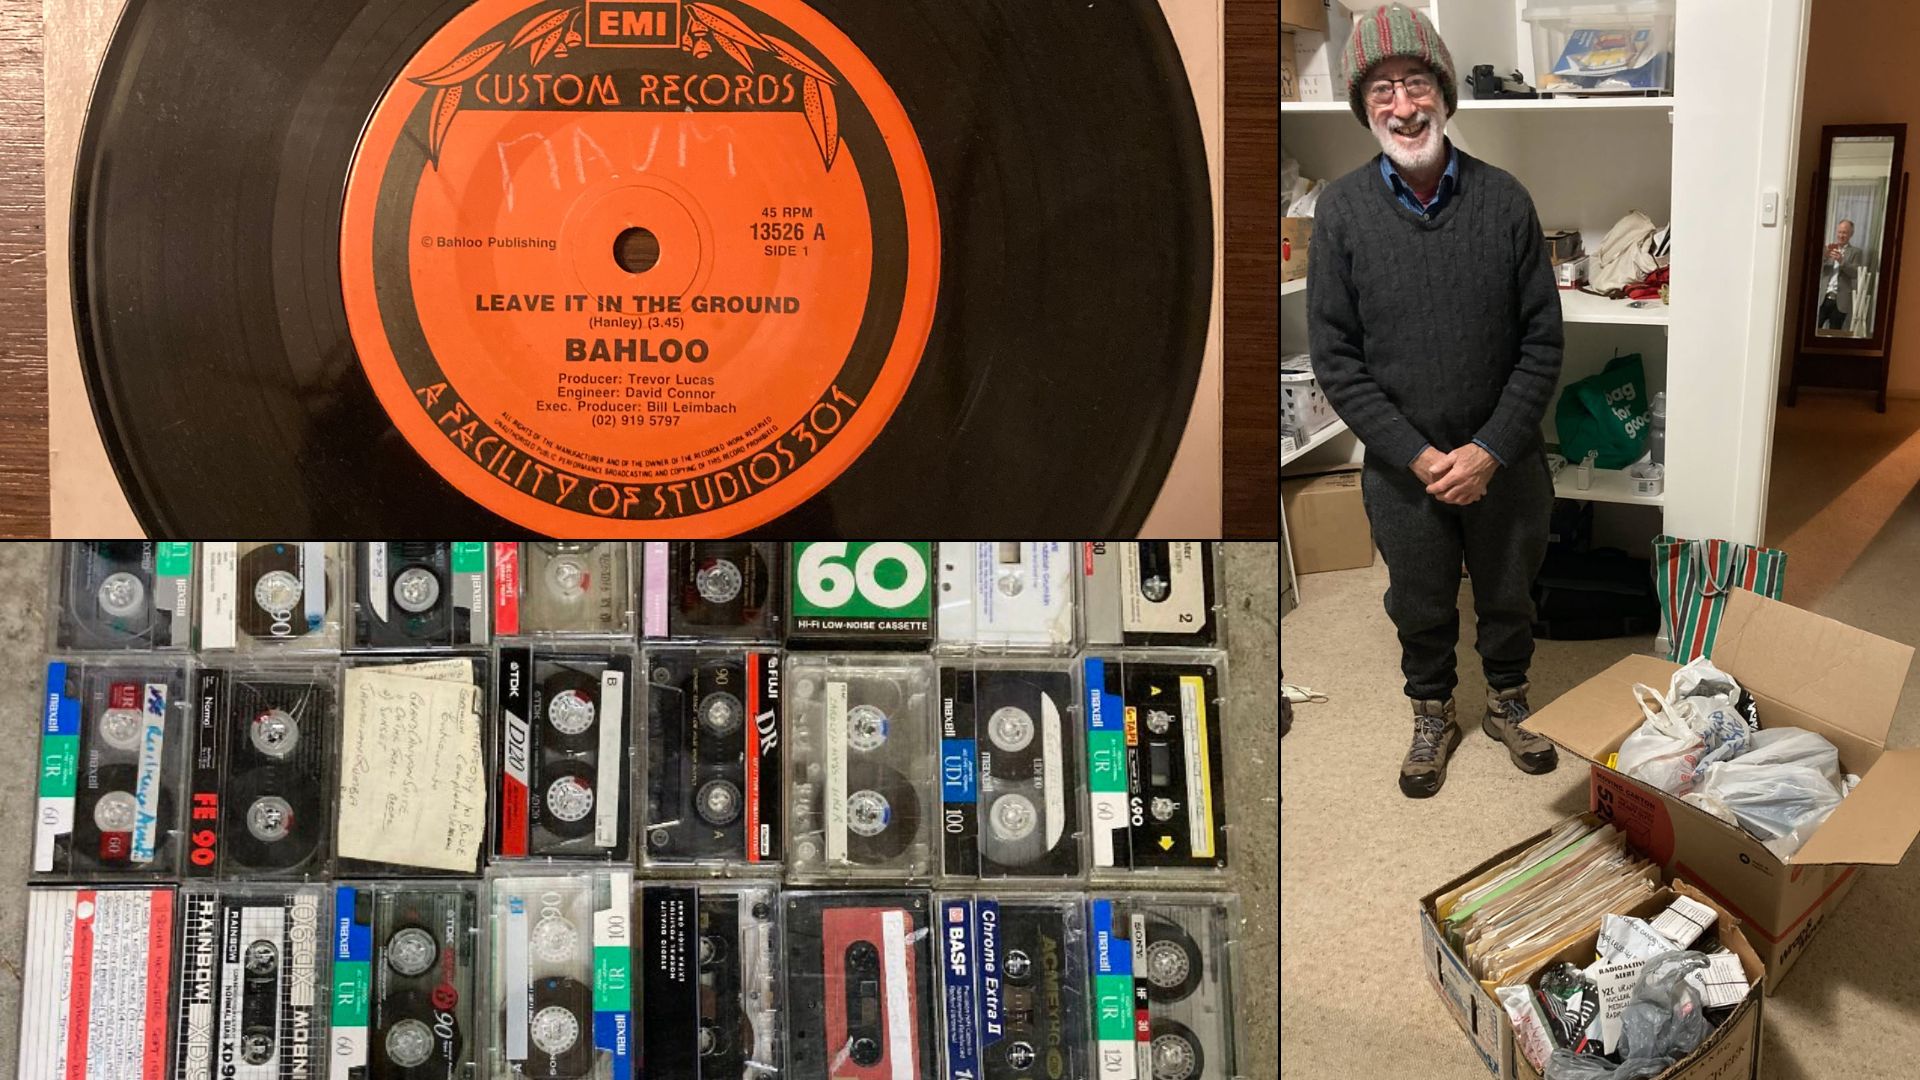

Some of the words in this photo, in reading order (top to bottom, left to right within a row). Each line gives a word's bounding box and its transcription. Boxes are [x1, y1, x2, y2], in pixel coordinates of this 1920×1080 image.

[601, 11, 667, 36] EMI
[475, 73, 619, 106] CUSTOM
[640, 73, 796, 106] RECORDS
[761, 207, 778, 219] 45
[782, 207, 814, 219] RPM
[436, 236, 484, 249] Bahloo
[487, 236, 557, 252] Publishing
[749, 223, 805, 242] 13526
[813, 224, 827, 242] A
[764, 245, 798, 257] SIDE
[802, 245, 809, 257] 1
[475, 295, 555, 313] LEAVE
[564, 295, 590, 313] IT
[597, 295, 624, 313] IN
[633, 295, 683, 314] THE
[691, 296, 800, 315] GROUND
[588, 316, 644, 331] (Hanley)
[647, 316, 685, 331] (3.45)
[564, 338, 710, 364] BAHLOO
[558, 373, 623, 386] Producer:
[628, 373, 671, 386] Trevor
[675, 374, 715, 387] Lucas
[557, 386, 620, 401] Engineer:
[625, 387, 662, 400] David
[665, 387, 716, 400] Connor
[536, 400, 573, 413] Exec.
[577, 400, 642, 413] Producer:
[647, 400, 669, 414] Bill
[673, 401, 737, 415] Leimbach
[1611, 404, 1632, 421] for
[591, 414, 617, 428] (02)
[621, 414, 646, 427] 919
[649, 414, 681, 427] 5797
[416, 382, 447, 408] A
[437, 402, 579, 507] FACILITY
[589, 484, 642, 518] OF
[653, 438, 797, 518] STUDIOS
[790, 384, 857, 455] 301
[797, 542, 928, 609] 60
[176, 578, 188, 617] maxell
[471, 574, 482, 613] maxell
[270, 609, 291, 635] 90
[798, 620, 820, 630] HI-FI
[822, 620, 876, 631] LOW-NOISE
[878, 621, 928, 632] CASSETTE
[1179, 613, 1193, 624] 2
[509, 669, 520, 698] TDK
[606, 676, 618, 687] B
[715, 668, 729, 685] 90
[767, 669, 779, 699] FUJI
[122, 685, 136, 708] UR
[1150, 686, 1163, 696] A
[48, 692, 60, 733] maxell
[203, 696, 215, 728] Normal
[532, 697, 541, 720] TDK
[944, 698, 956, 737] maxell
[1091, 689, 1104, 728] maxell
[753, 708, 779, 757] DR
[45, 755, 59, 778] UR
[87, 750, 99, 790] maxell
[945, 755, 962, 787] UDI
[981, 752, 992, 792] maxell
[1095, 750, 1111, 773] UR
[41, 807, 59, 826] 60
[193, 793, 218, 820] FE
[1096, 801, 1115, 821] 60
[946, 808, 964, 834] 100
[108, 837, 122, 854] 60
[191, 829, 217, 866] 90
[714, 830, 724, 840] A
[541, 891, 563, 920] 90
[660, 900, 668, 936] QUALITY
[677, 900, 685, 928] GRADE
[290, 904, 317, 946] 90
[445, 919, 456, 944] TDK
[608, 915, 625, 941] 100
[669, 900, 677, 941] POSITION
[227, 911, 239, 963] RAINBOW
[339, 918, 351, 959] maxell
[981, 910, 997, 974] Chrome
[1133, 921, 1144, 960] SONY
[192, 901, 214, 1006] RAINBOW
[949, 927, 967, 977] BASF
[1099, 930, 1111, 972] maxell
[609, 966, 626, 991] UR
[678, 956, 686, 982] EXTRA
[1614, 970, 1635, 980] ALERT
[224, 985, 234, 1020] NORMAL
[338, 981, 355, 1007] UR
[984, 977, 1000, 1019] Extra
[1136, 987, 1147, 1000] HF
[1102, 996, 1118, 1020] UR
[433, 1009, 454, 1039] 90
[614, 1014, 627, 1057] maxell
[1137, 1018, 1149, 1032] 30
[222, 1042, 235, 1063] XD
[335, 1036, 354, 1057] 60
[514, 1063, 523, 1073] A
[1103, 1048, 1122, 1073] 120
